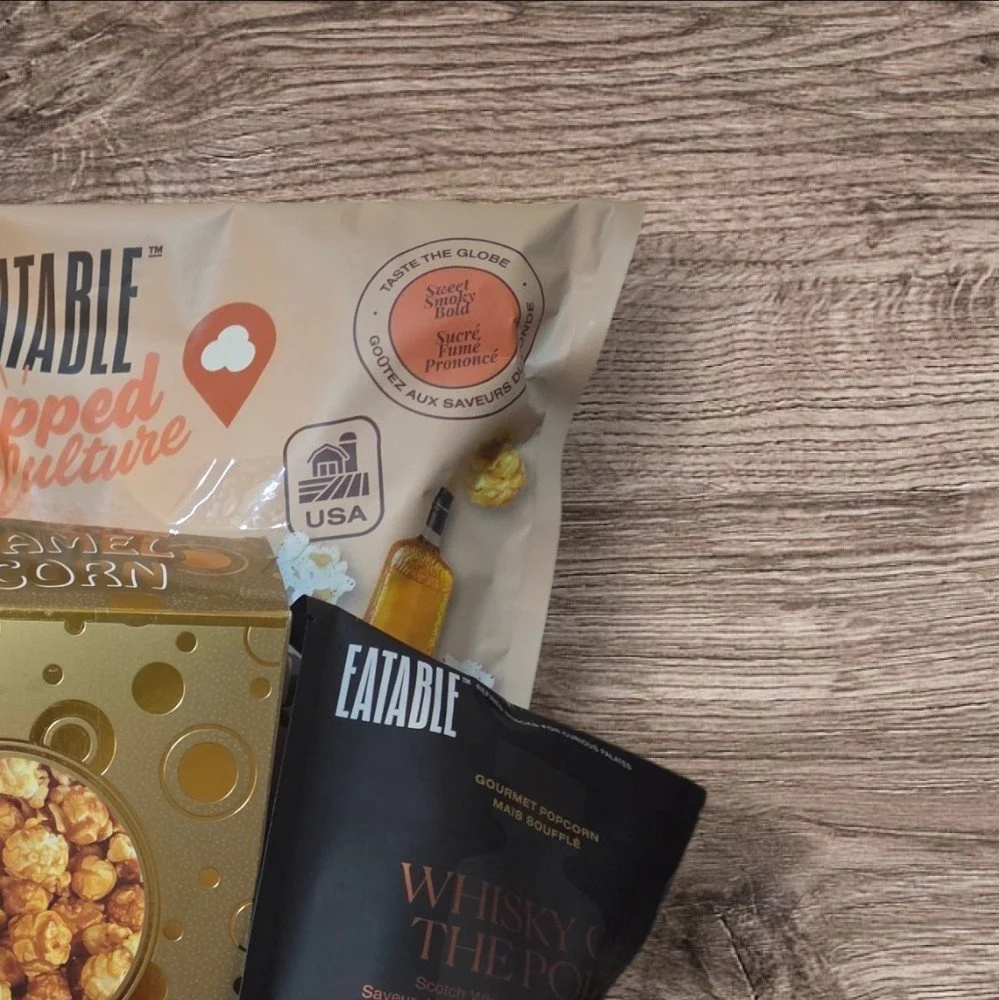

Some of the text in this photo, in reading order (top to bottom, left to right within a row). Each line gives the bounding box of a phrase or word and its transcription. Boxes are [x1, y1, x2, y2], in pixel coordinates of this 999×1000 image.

[380, 248, 511, 293] TASTE THE GLOBE
[425, 291, 476, 309] Smoky
[426, 279, 469, 297] Sweet
[435, 300, 470, 319] Bold
[436, 323, 481, 345] Sucré
[369, 335, 407, 391] GOÛTEZ
[405, 389, 438, 407] AUX
[443, 383, 512, 408] SAVEURS
[518, 302, 534, 356] ONDE
[425, 348, 499, 373] Prononcé
[305, 504, 368, 529] USA
[335, 643, 460, 738] EATABLE
[475, 774, 600, 843] GOURMET POPCORN
[526, 815, 581, 849] SOUFFLÉ
[401, 861, 577, 953] WHISKY
[411, 916, 515, 981] THE
[415, 976, 468, 1000] Scotch
